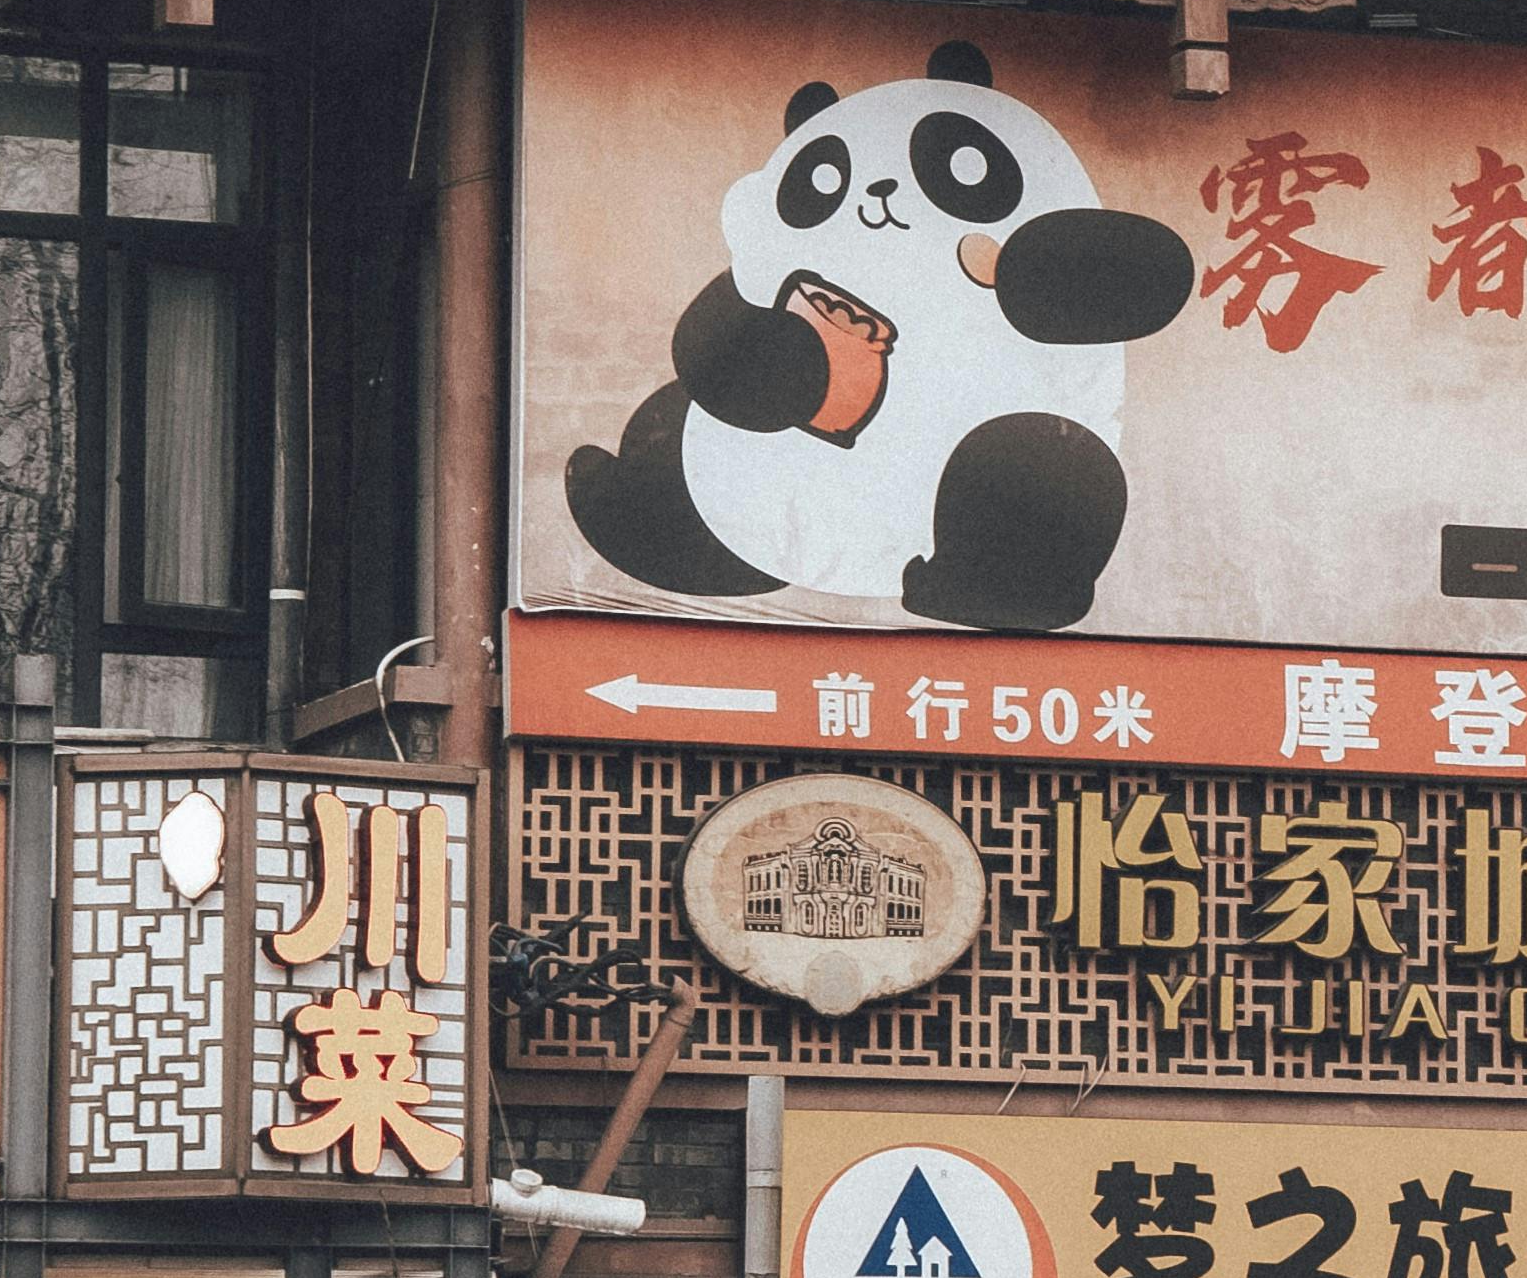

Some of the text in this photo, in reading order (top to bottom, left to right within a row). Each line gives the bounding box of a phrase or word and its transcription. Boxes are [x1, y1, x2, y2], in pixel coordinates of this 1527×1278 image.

[812, 669, 1155, 748] 前行50米
[265, 791, 465, 1176] 川菜
[1278, 978, 1449, 1041] JIA
